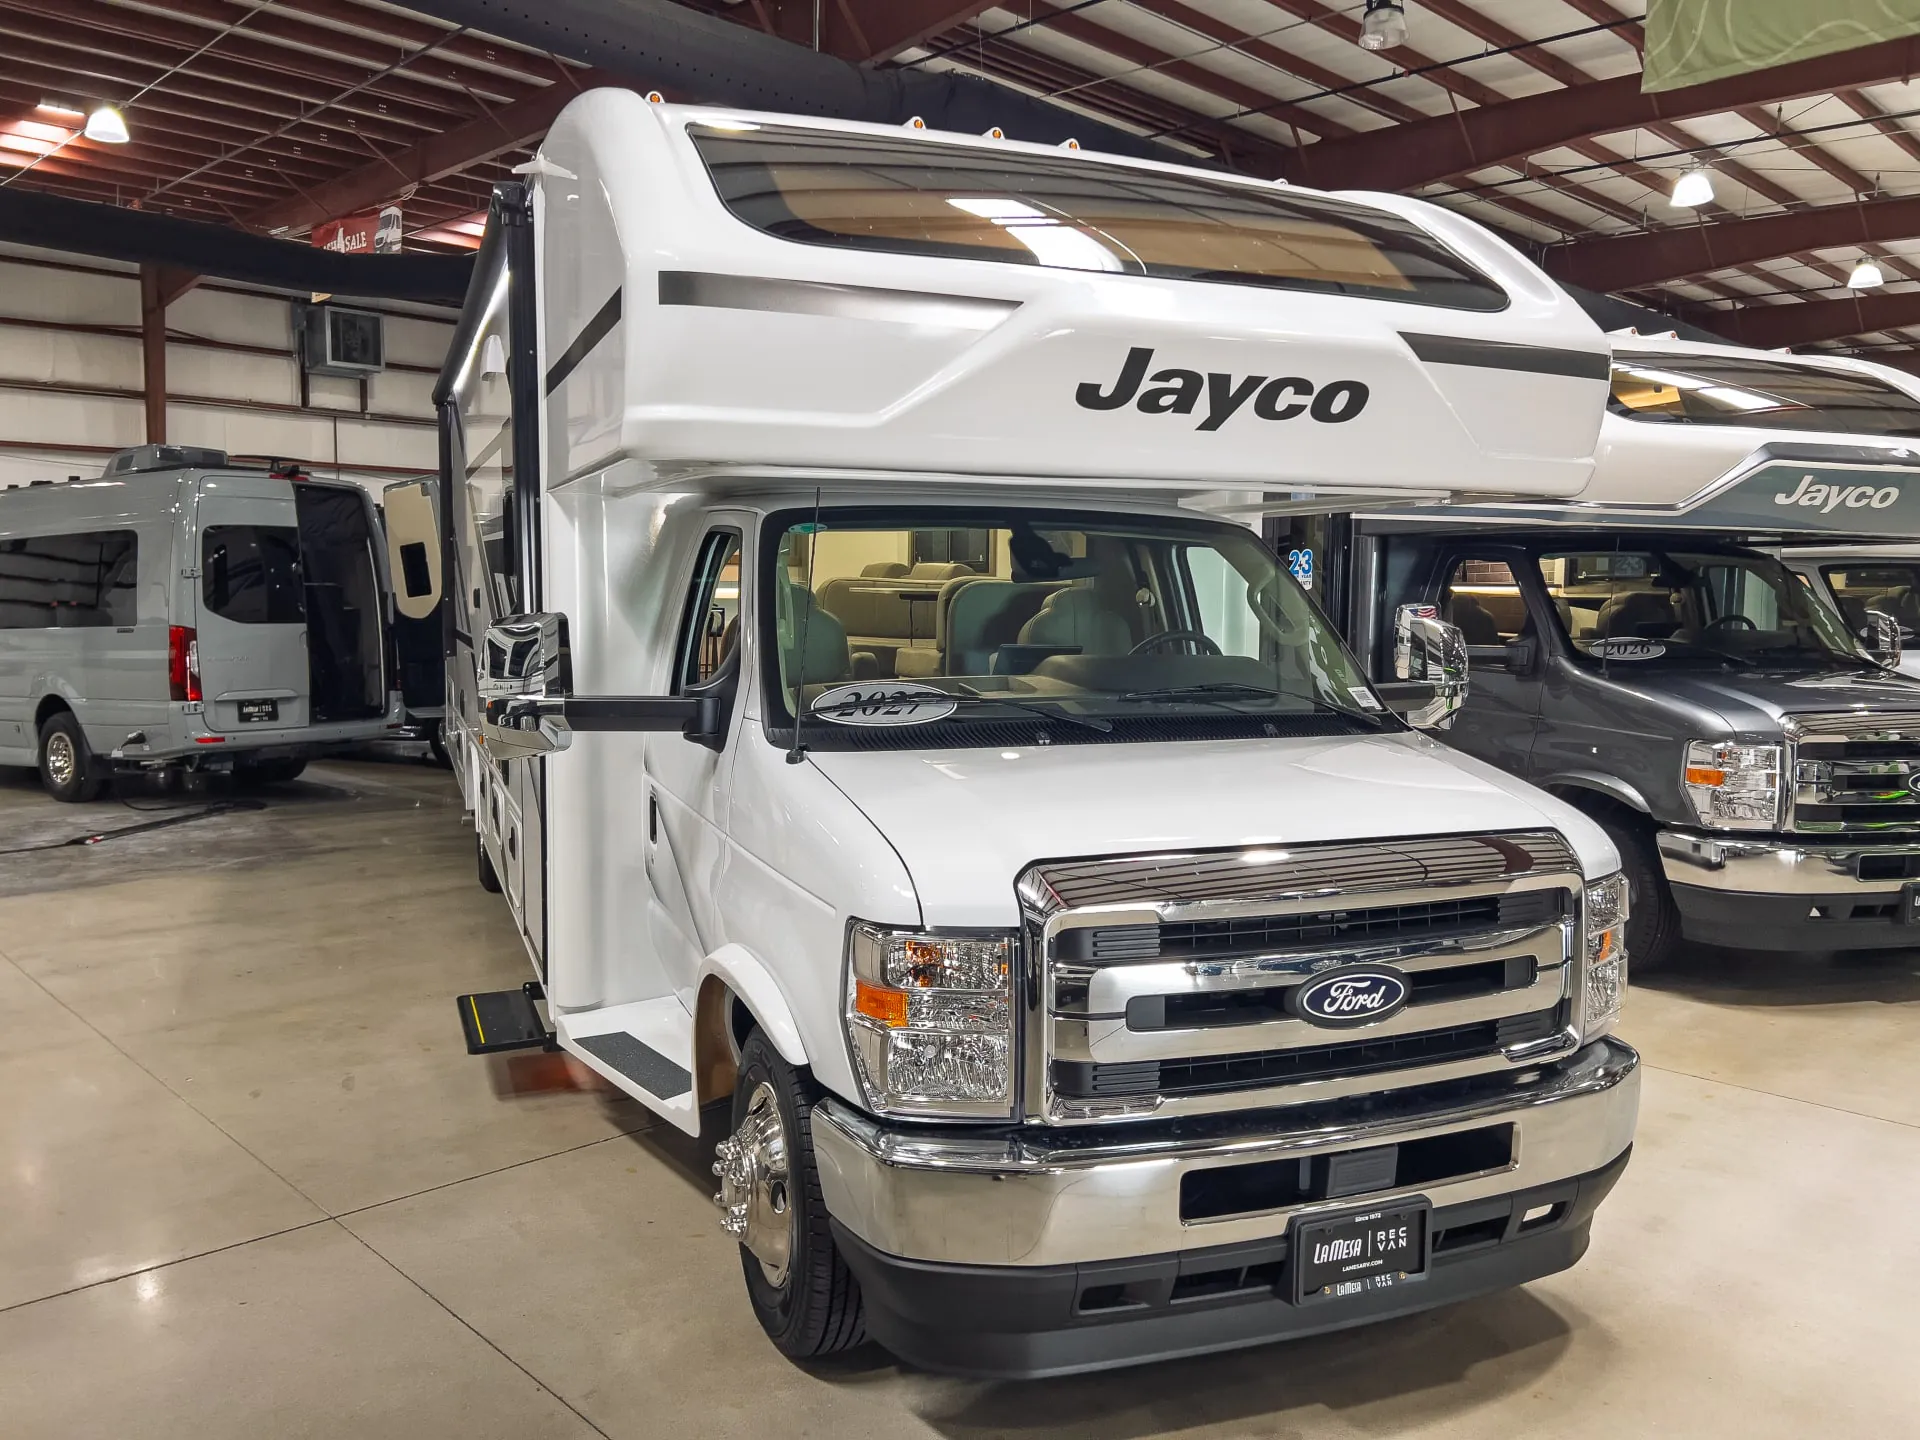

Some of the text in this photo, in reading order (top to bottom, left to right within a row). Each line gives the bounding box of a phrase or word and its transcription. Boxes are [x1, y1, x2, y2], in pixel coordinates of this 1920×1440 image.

[345, 231, 367, 251] SALE
[1075, 346, 1370, 431] Jayco
[1774, 475, 1900, 513] Jayco
[1605, 642, 1651, 656] 2026
[1323, 980, 1386, 1013] Ford
[1377, 1226, 1407, 1241] REC
[1377, 1237, 1407, 1252] VAN
[1342, 1260, 1383, 1271] LAMESARV.COM
[1375, 1273, 1391, 1282] REC
[1376, 1279, 1392, 1288] VAN
